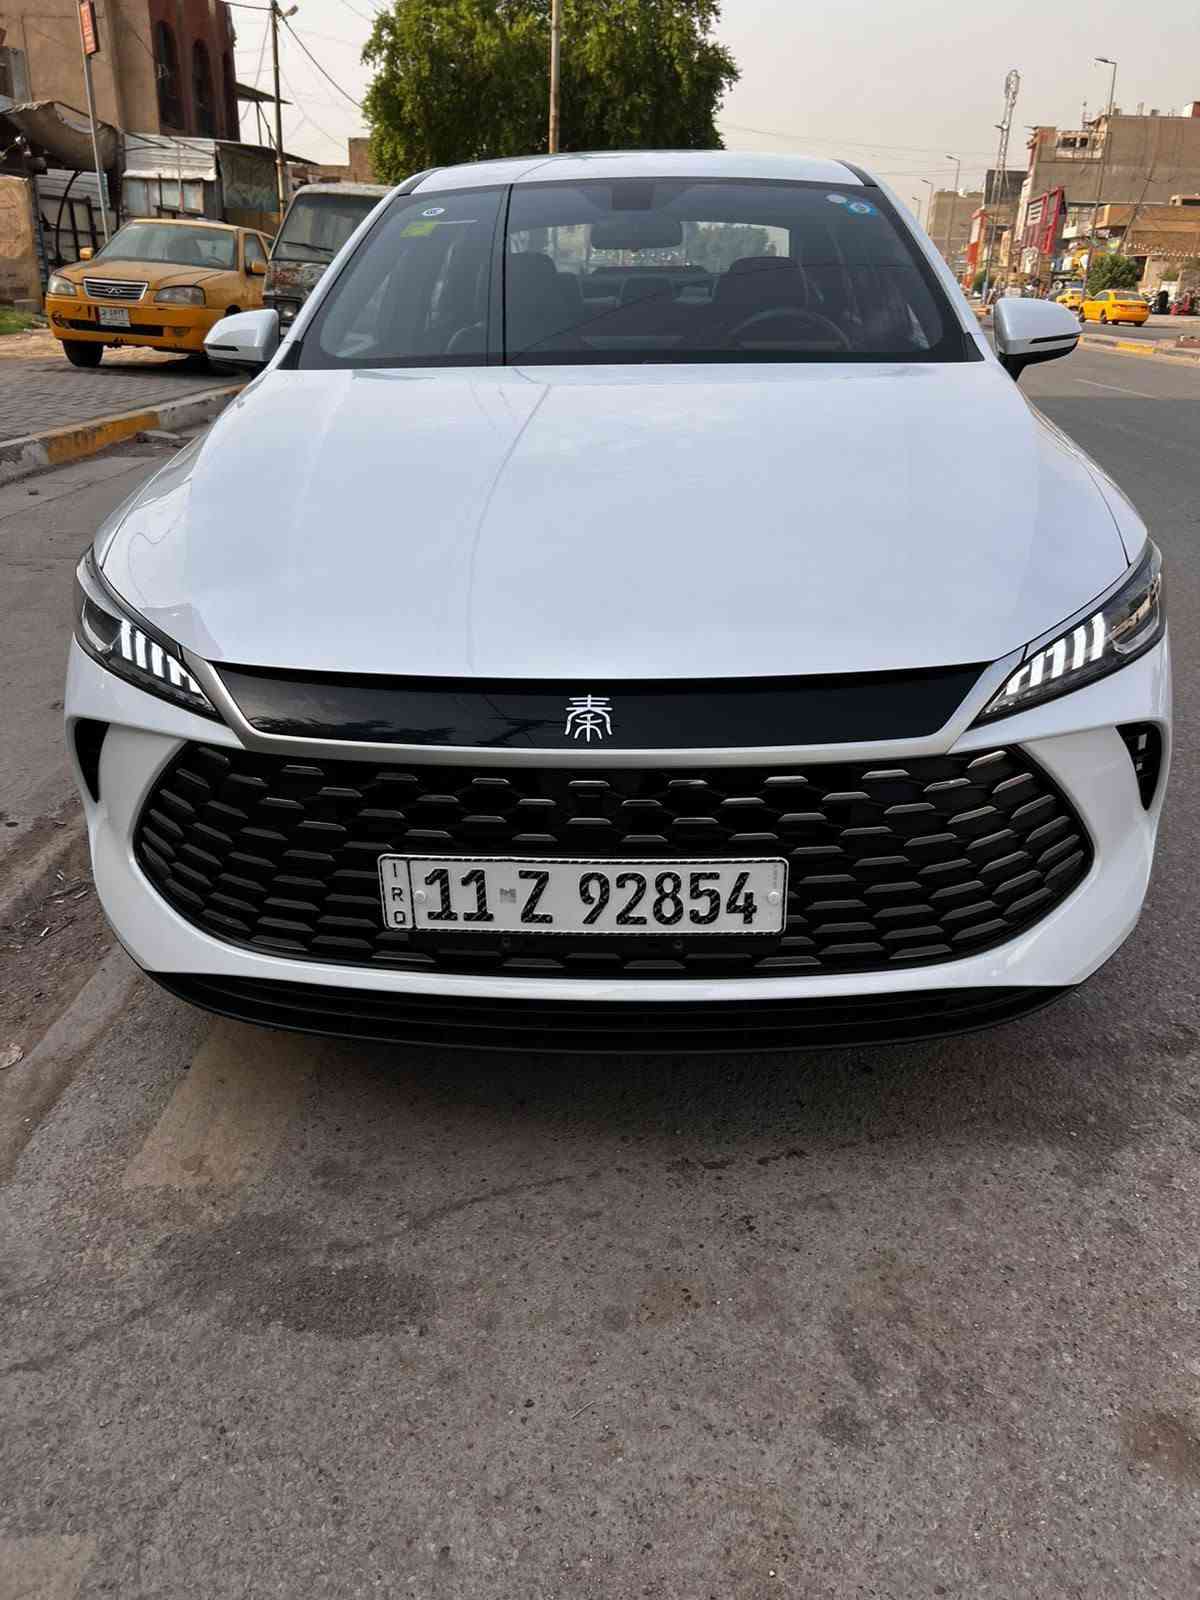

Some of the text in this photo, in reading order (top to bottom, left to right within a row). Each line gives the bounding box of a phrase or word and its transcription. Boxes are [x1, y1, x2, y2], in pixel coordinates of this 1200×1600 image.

[424, 868, 495, 922] 11
[518, 870, 553, 924] Z
[578, 871, 758, 925] 92854
